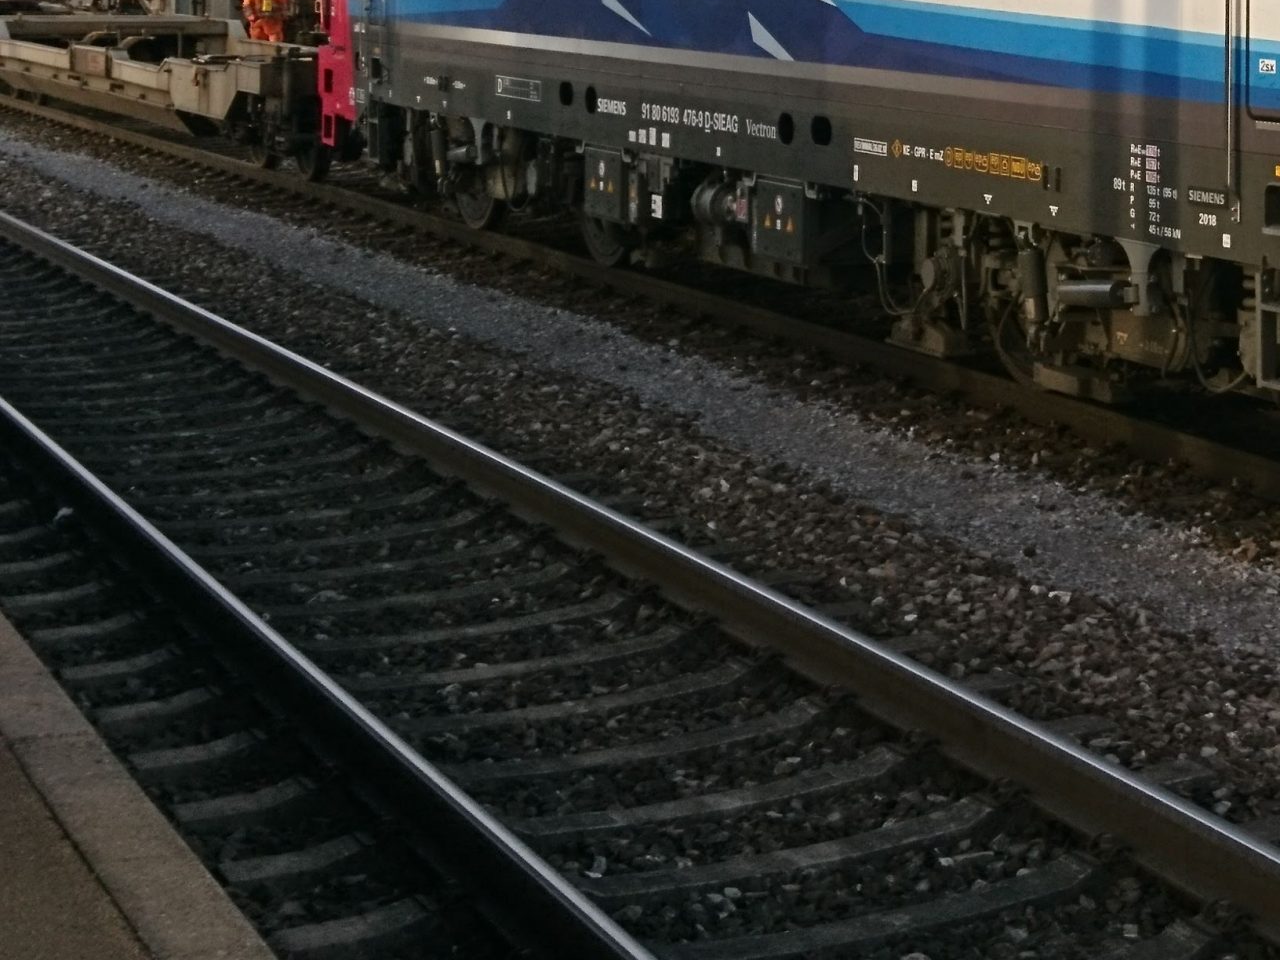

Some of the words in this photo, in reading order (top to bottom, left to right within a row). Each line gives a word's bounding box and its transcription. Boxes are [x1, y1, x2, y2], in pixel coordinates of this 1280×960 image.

[597, 97, 627, 116] SIEMENS
[641, 102, 650, 120] 91
[651, 104, 660, 121] 80
[661, 106, 680, 124] 6193
[746, 119, 777, 139] Vectron
[1188, 190, 1225, 205] SIEMENS
[1199, 212, 1217, 227] 2018
